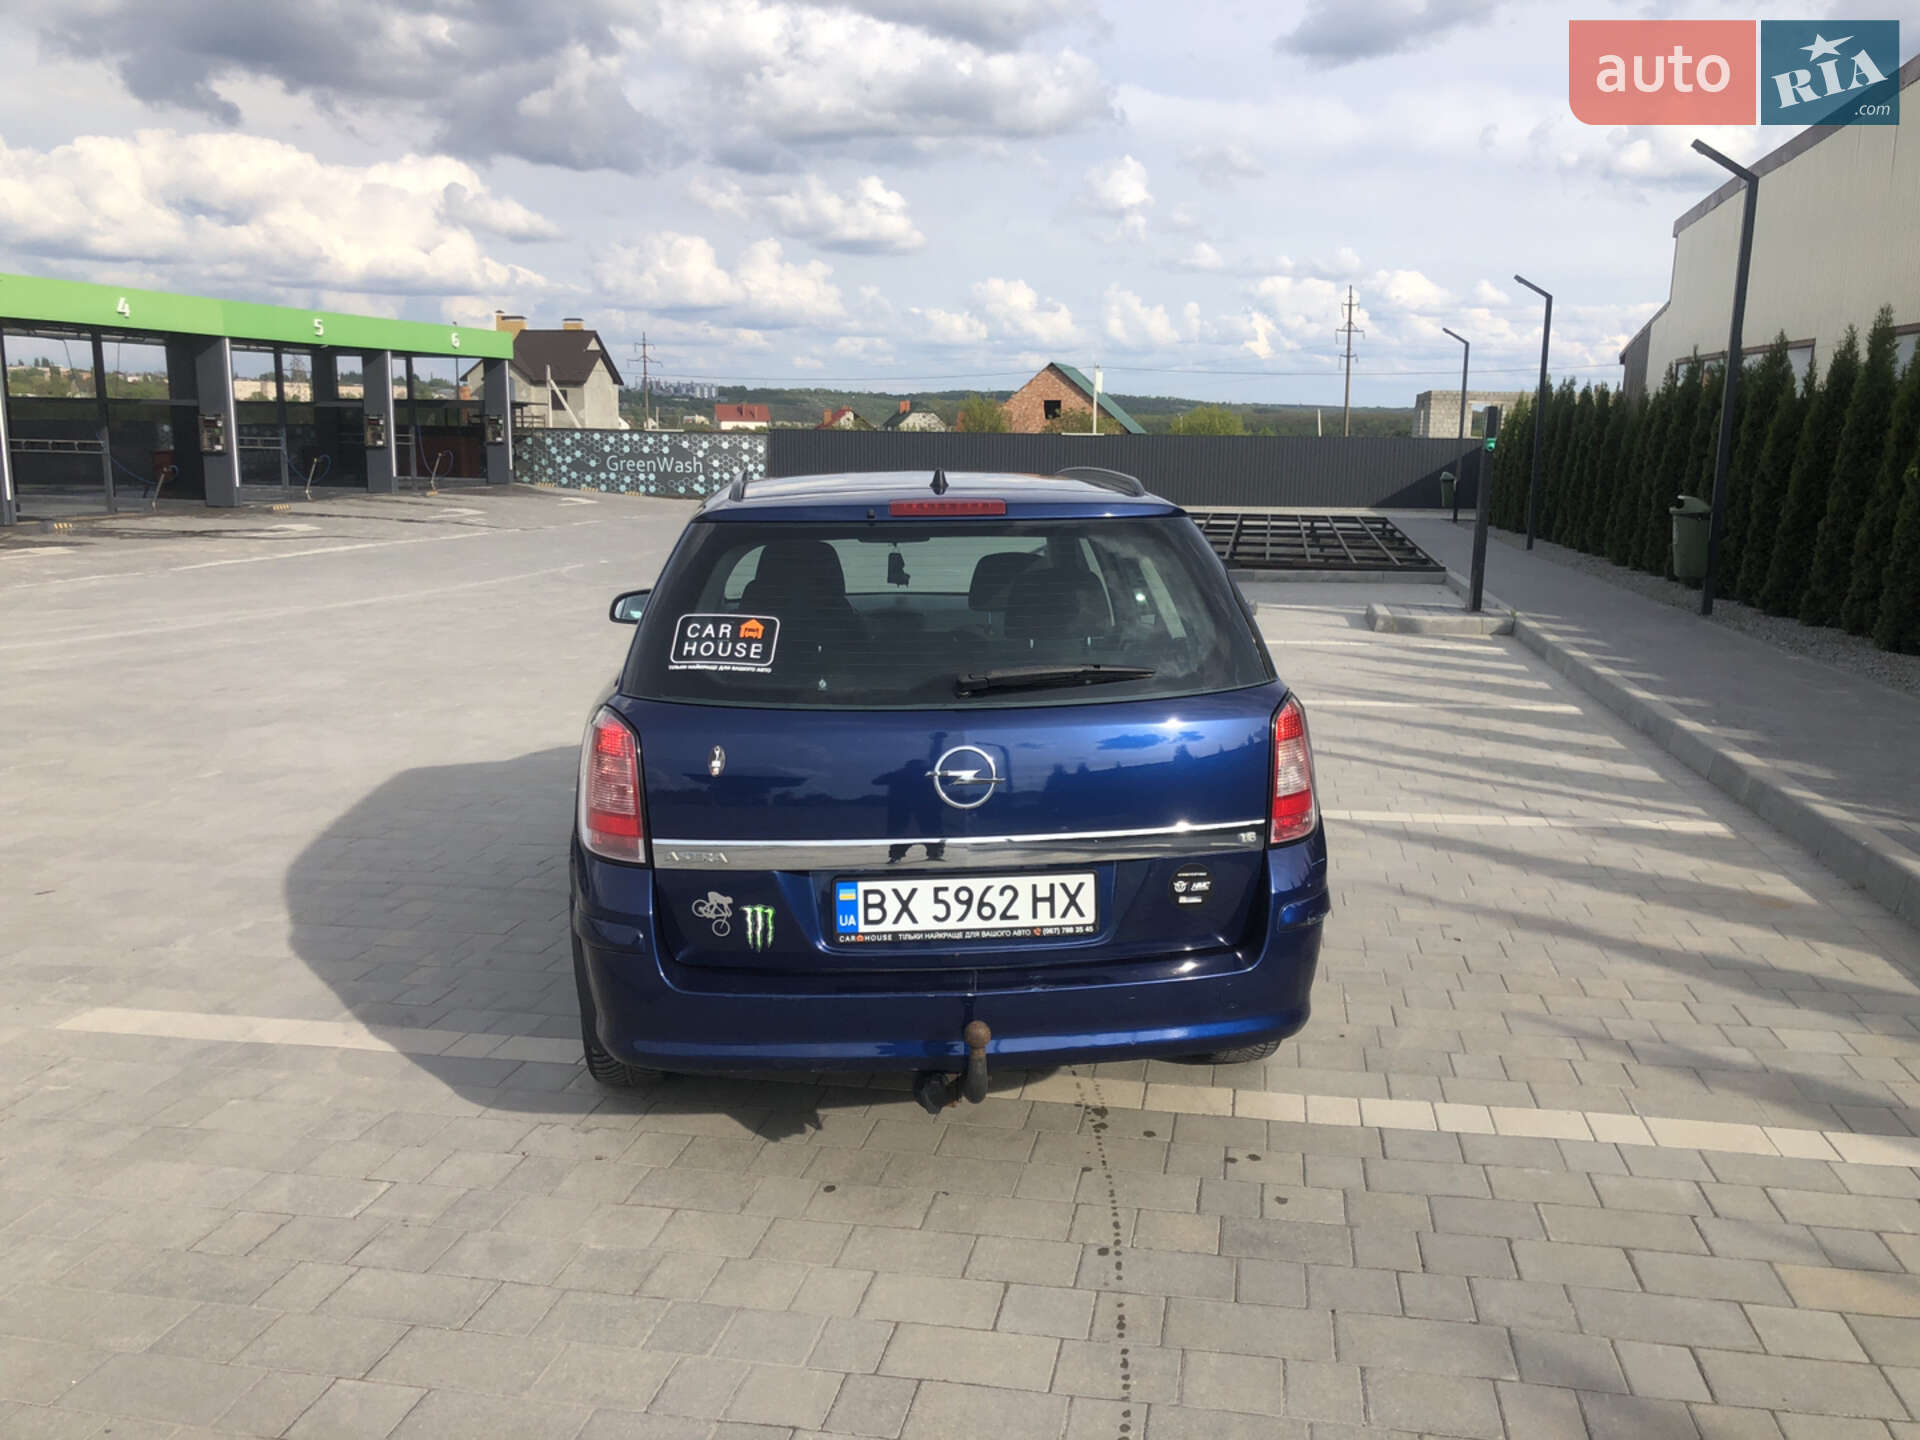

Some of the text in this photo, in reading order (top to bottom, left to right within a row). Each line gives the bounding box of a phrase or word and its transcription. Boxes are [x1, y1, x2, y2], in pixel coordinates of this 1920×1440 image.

[117, 296, 130, 317] 4
[314, 318, 325, 336] 5
[451, 332, 460, 348] 6
[606, 455, 704, 474] GreenWash
[686, 623, 732, 639] CAR
[682, 641, 763, 659] HOUSE
[863, 882, 1086, 925] BX 5962 HX
[839, 914, 857, 927] UA
[839, 933, 893, 943] CAR HOUSE
[1012, 928, 1032, 937] АВТО
